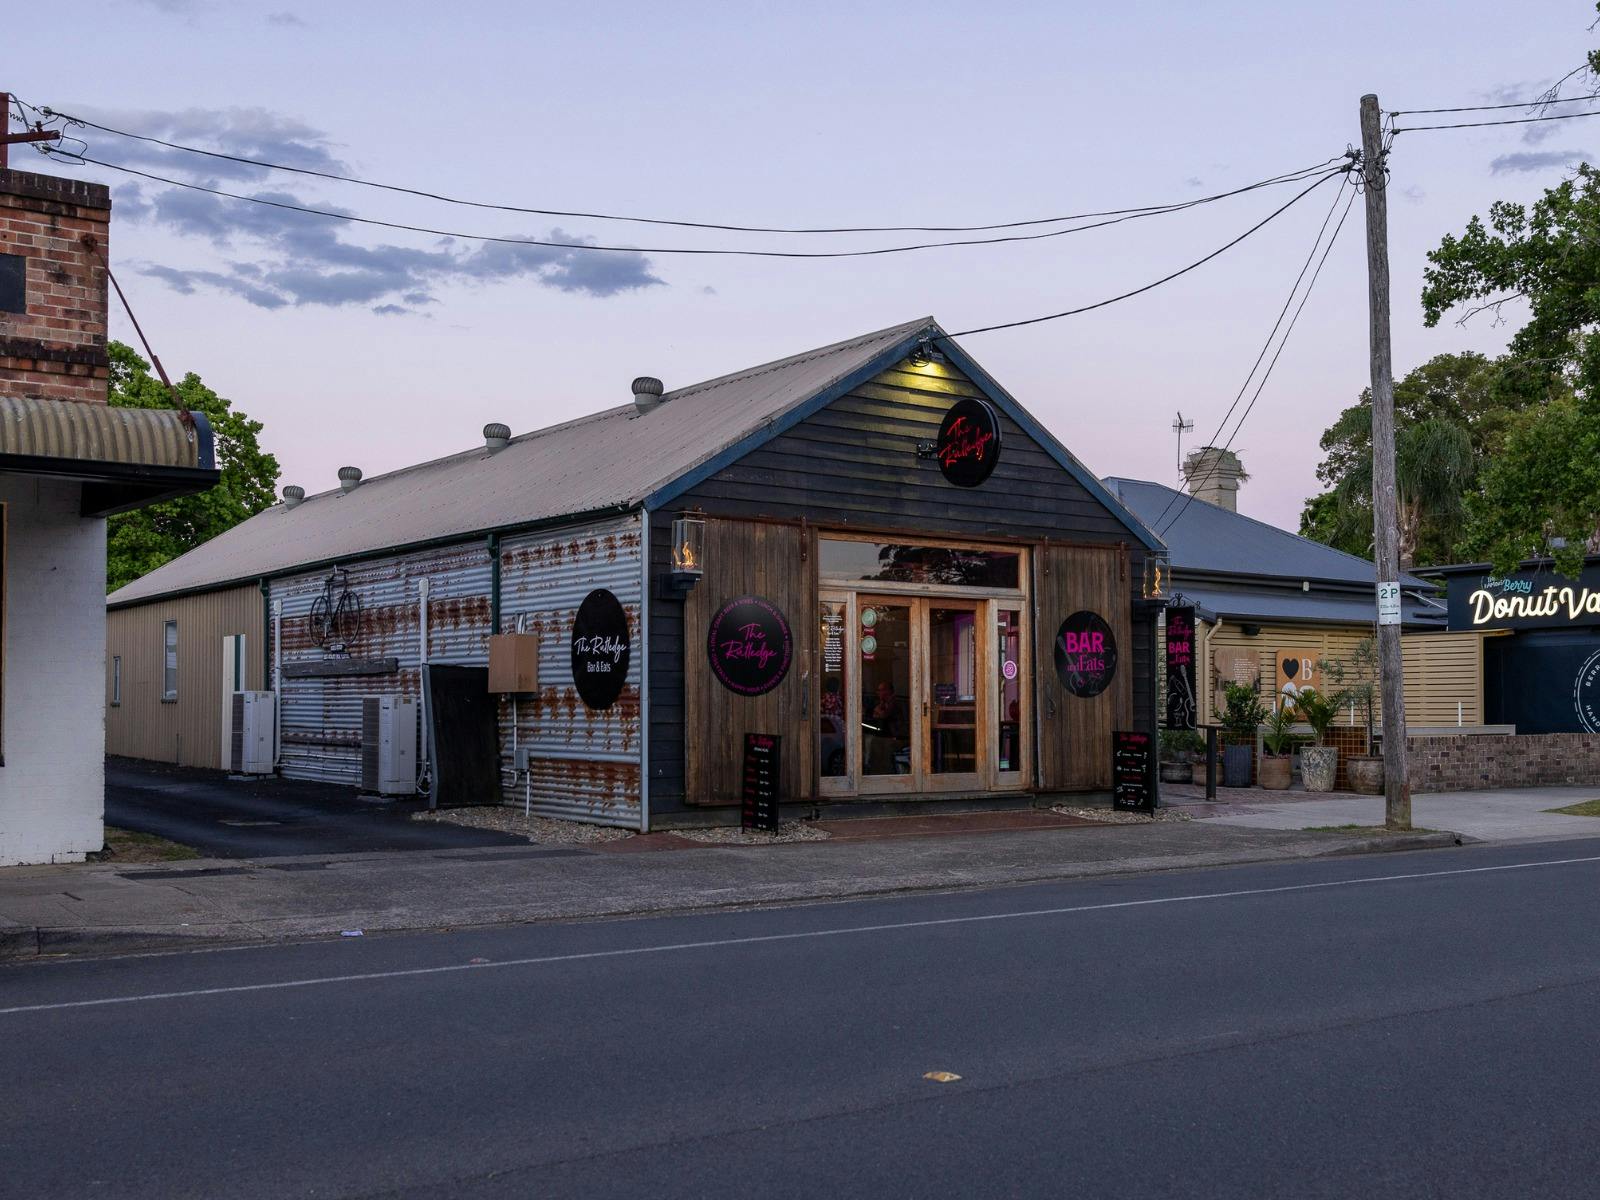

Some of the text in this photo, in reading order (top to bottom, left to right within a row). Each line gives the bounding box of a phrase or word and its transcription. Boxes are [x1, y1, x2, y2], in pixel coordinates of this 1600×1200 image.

[946, 416, 973, 442] The
[1381, 588, 1398, 599] 2P
[1503, 579, 1532, 594] Berry
[1469, 586, 1558, 624] Donut
[738, 622, 767, 642] The
[1066, 631, 1104, 653] BAR
[574, 636, 590, 655] The
[590, 634, 627, 663] Rutledge
[1168, 641, 1191, 654] BAR
[587, 661, 596, 672] Bar
[600, 661, 611, 672] Eats
[1302, 658, 1312, 680] B
